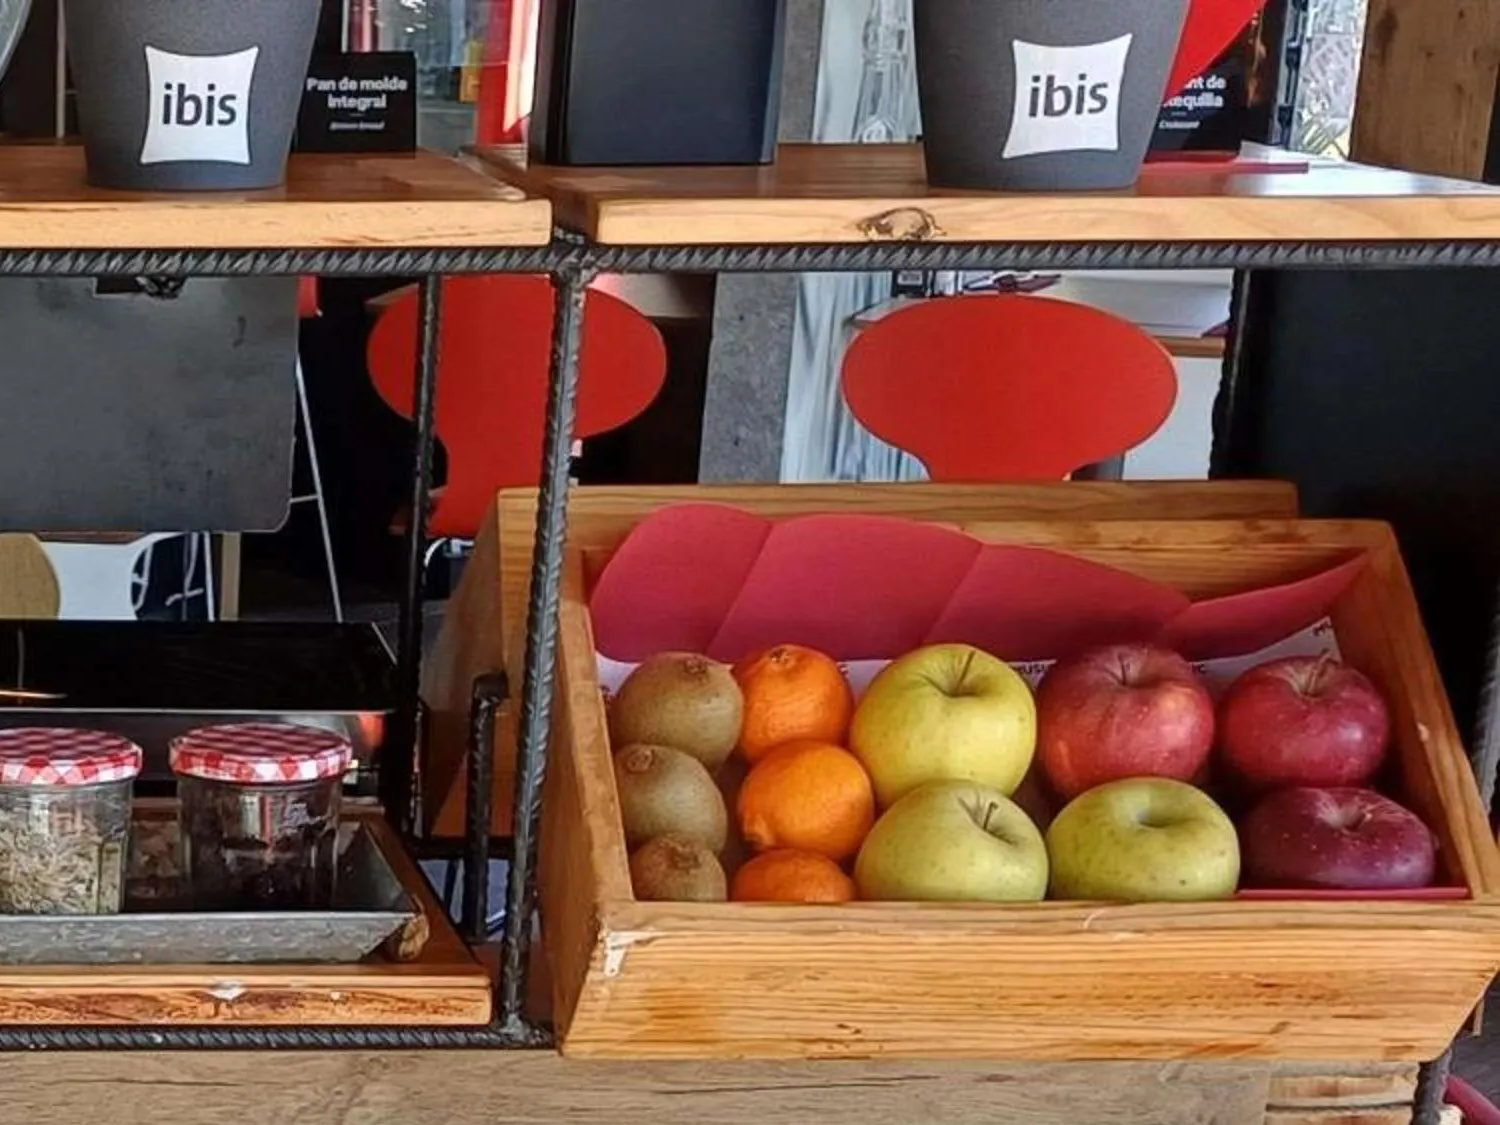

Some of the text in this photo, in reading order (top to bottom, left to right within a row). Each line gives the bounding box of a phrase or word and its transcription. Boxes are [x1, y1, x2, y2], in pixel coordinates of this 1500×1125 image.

[306, 75, 408, 91] Pan de molde
[1028, 73, 1109, 117] ibis
[1205, 74, 1227, 89] de
[162, 82, 237, 126] ibis
